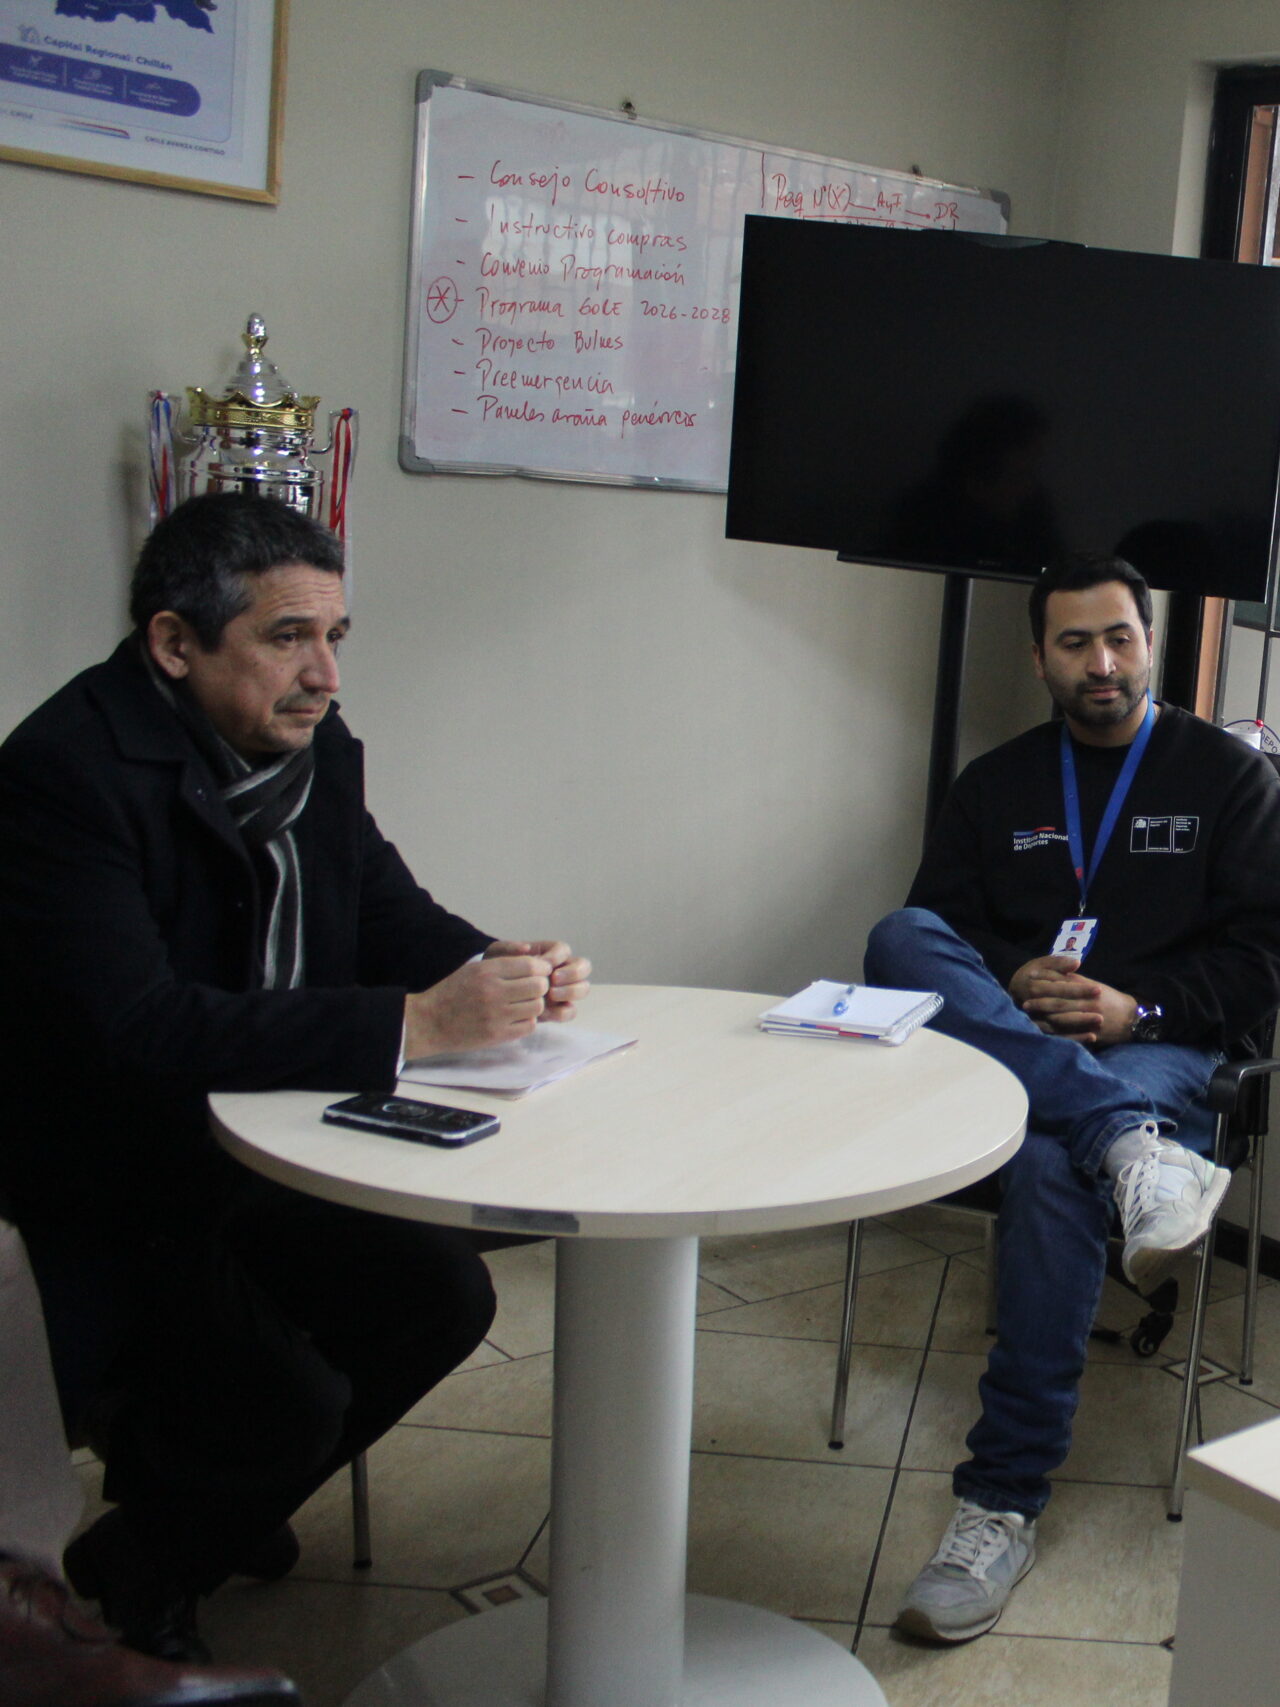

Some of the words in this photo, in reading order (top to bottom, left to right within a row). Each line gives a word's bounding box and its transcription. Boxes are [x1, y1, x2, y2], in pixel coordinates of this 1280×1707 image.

[44, 35, 83, 53] Capital
[490, 160, 571, 206] Consejo
[490, 203, 595, 240] Instructivo
[480, 252, 551, 279] Convenio
[475, 286, 565, 325] Programa
[640, 300, 731, 324] 2026-2028
[475, 327, 556, 358] Proyecto
[1038, 832, 1069, 842] Nacional
